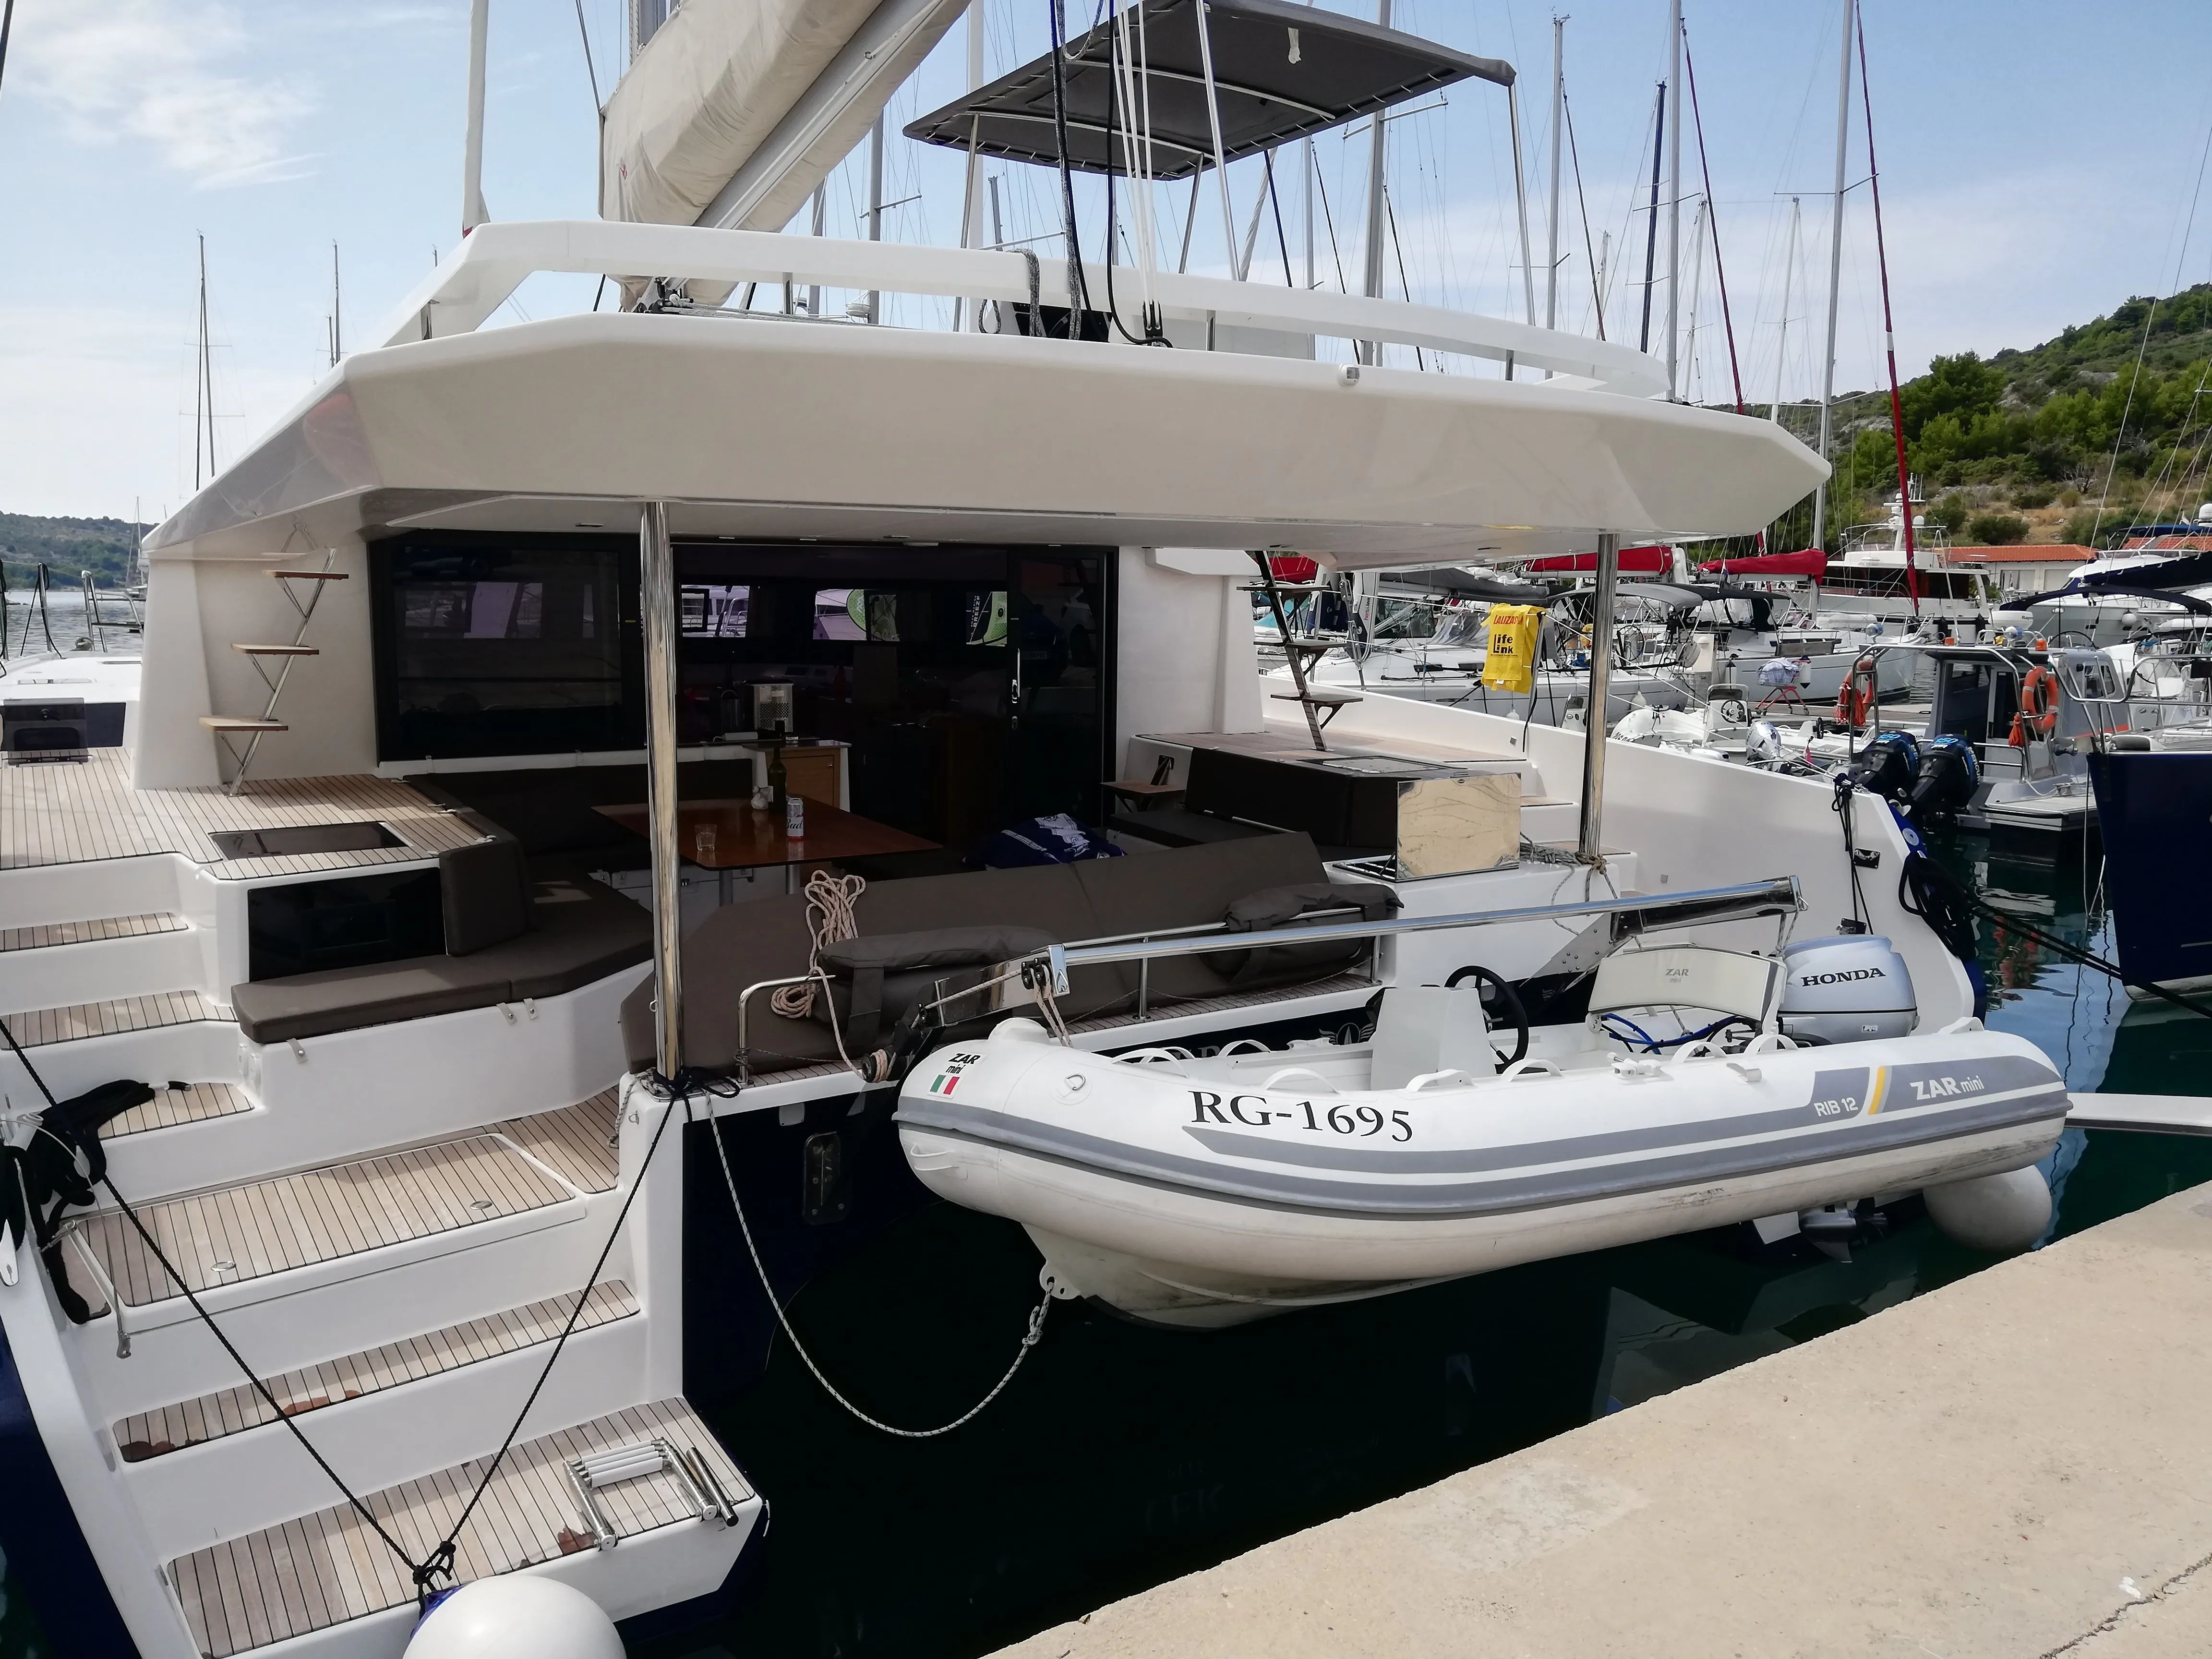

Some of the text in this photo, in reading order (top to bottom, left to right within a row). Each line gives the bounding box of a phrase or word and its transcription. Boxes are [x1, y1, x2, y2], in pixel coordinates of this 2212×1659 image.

[1493, 614, 1518, 625] LALIZAS
[1665, 968, 1689, 976] ZAR
[1801, 967, 1886, 987] HONDA
[948, 1053, 981, 1065] ZAR
[945, 1064, 966, 1074] mini
[1909, 1075, 1985, 1101] ZAR mini
[1814, 1097, 1859, 1117] RIB 12
[1187, 1090, 1413, 1142] RG-1695
